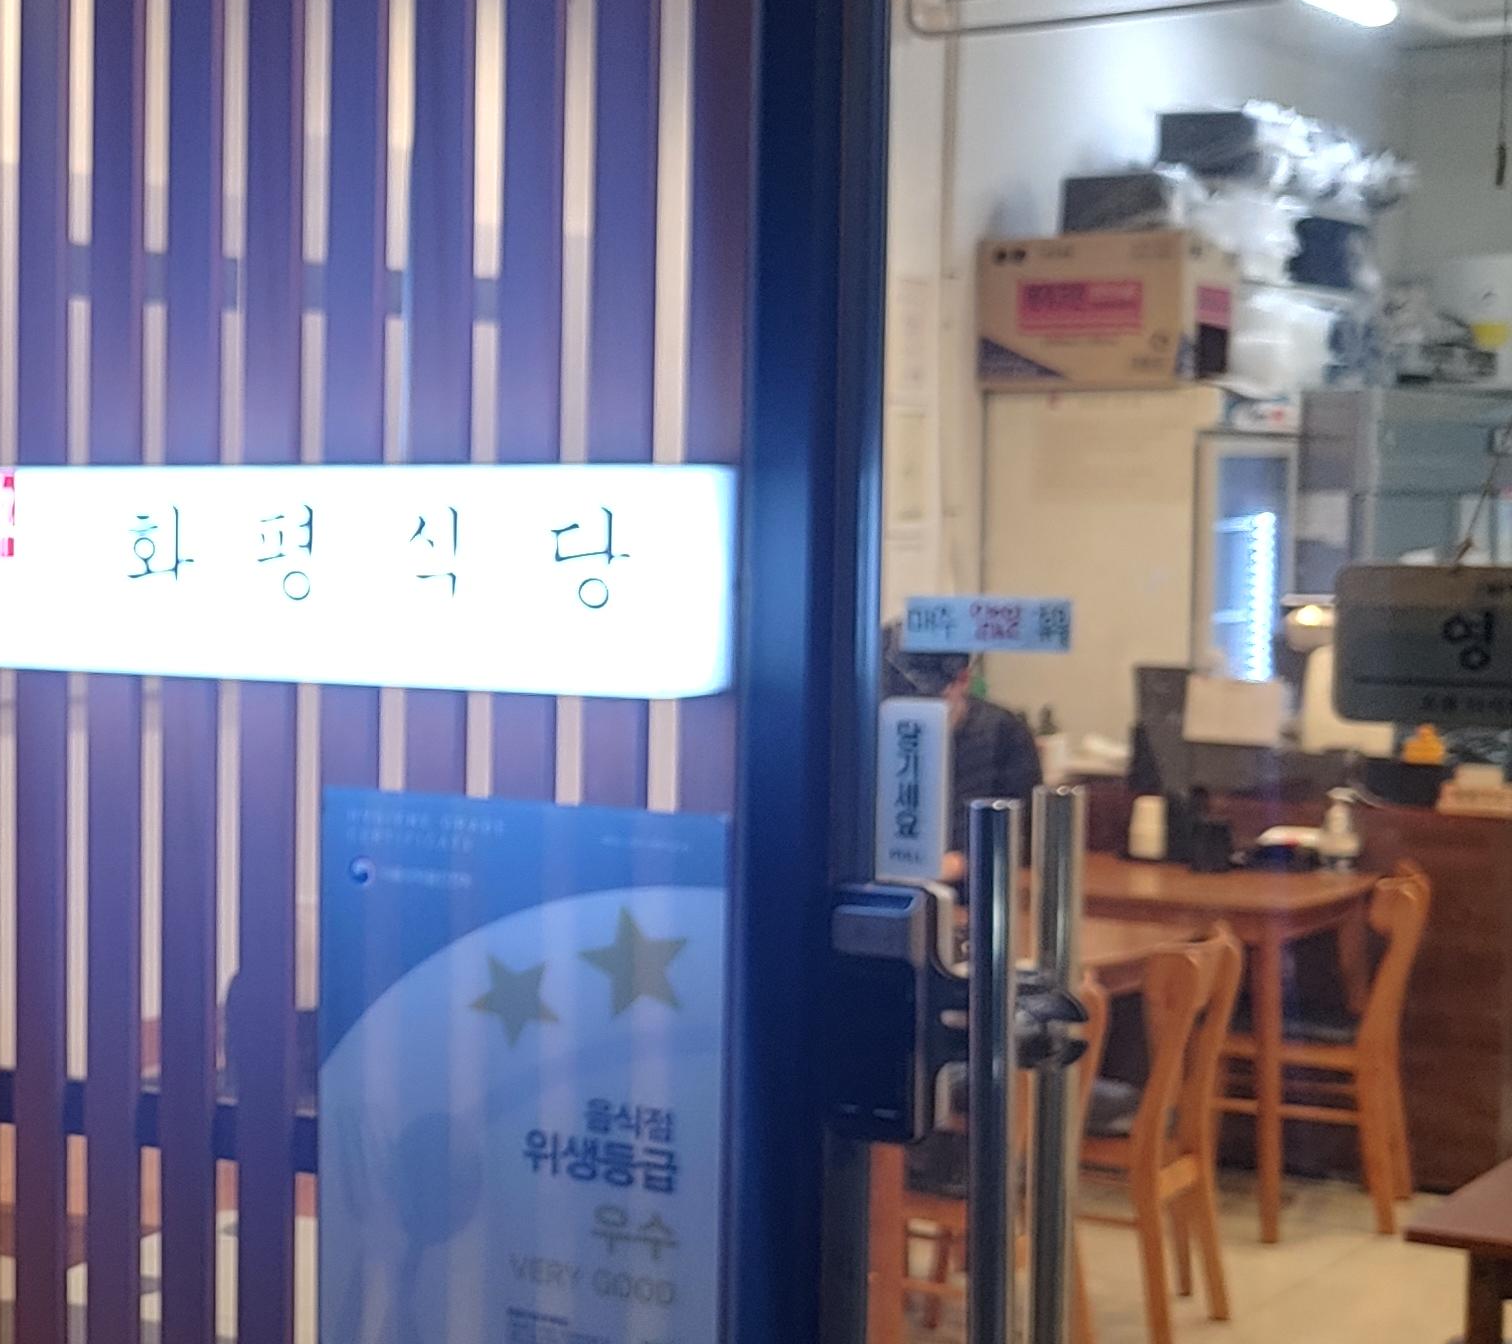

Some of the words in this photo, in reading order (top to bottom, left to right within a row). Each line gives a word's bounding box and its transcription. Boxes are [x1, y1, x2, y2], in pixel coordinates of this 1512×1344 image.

[127, 504, 630, 609] 화평식당
[894, 719, 922, 840] 당기세요
[585, 1098, 674, 1143] 음식점
[522, 1129, 679, 1195] 위생등급
[590, 1205, 679, 1260] 우수
[593, 1268, 676, 1306] GOOD
